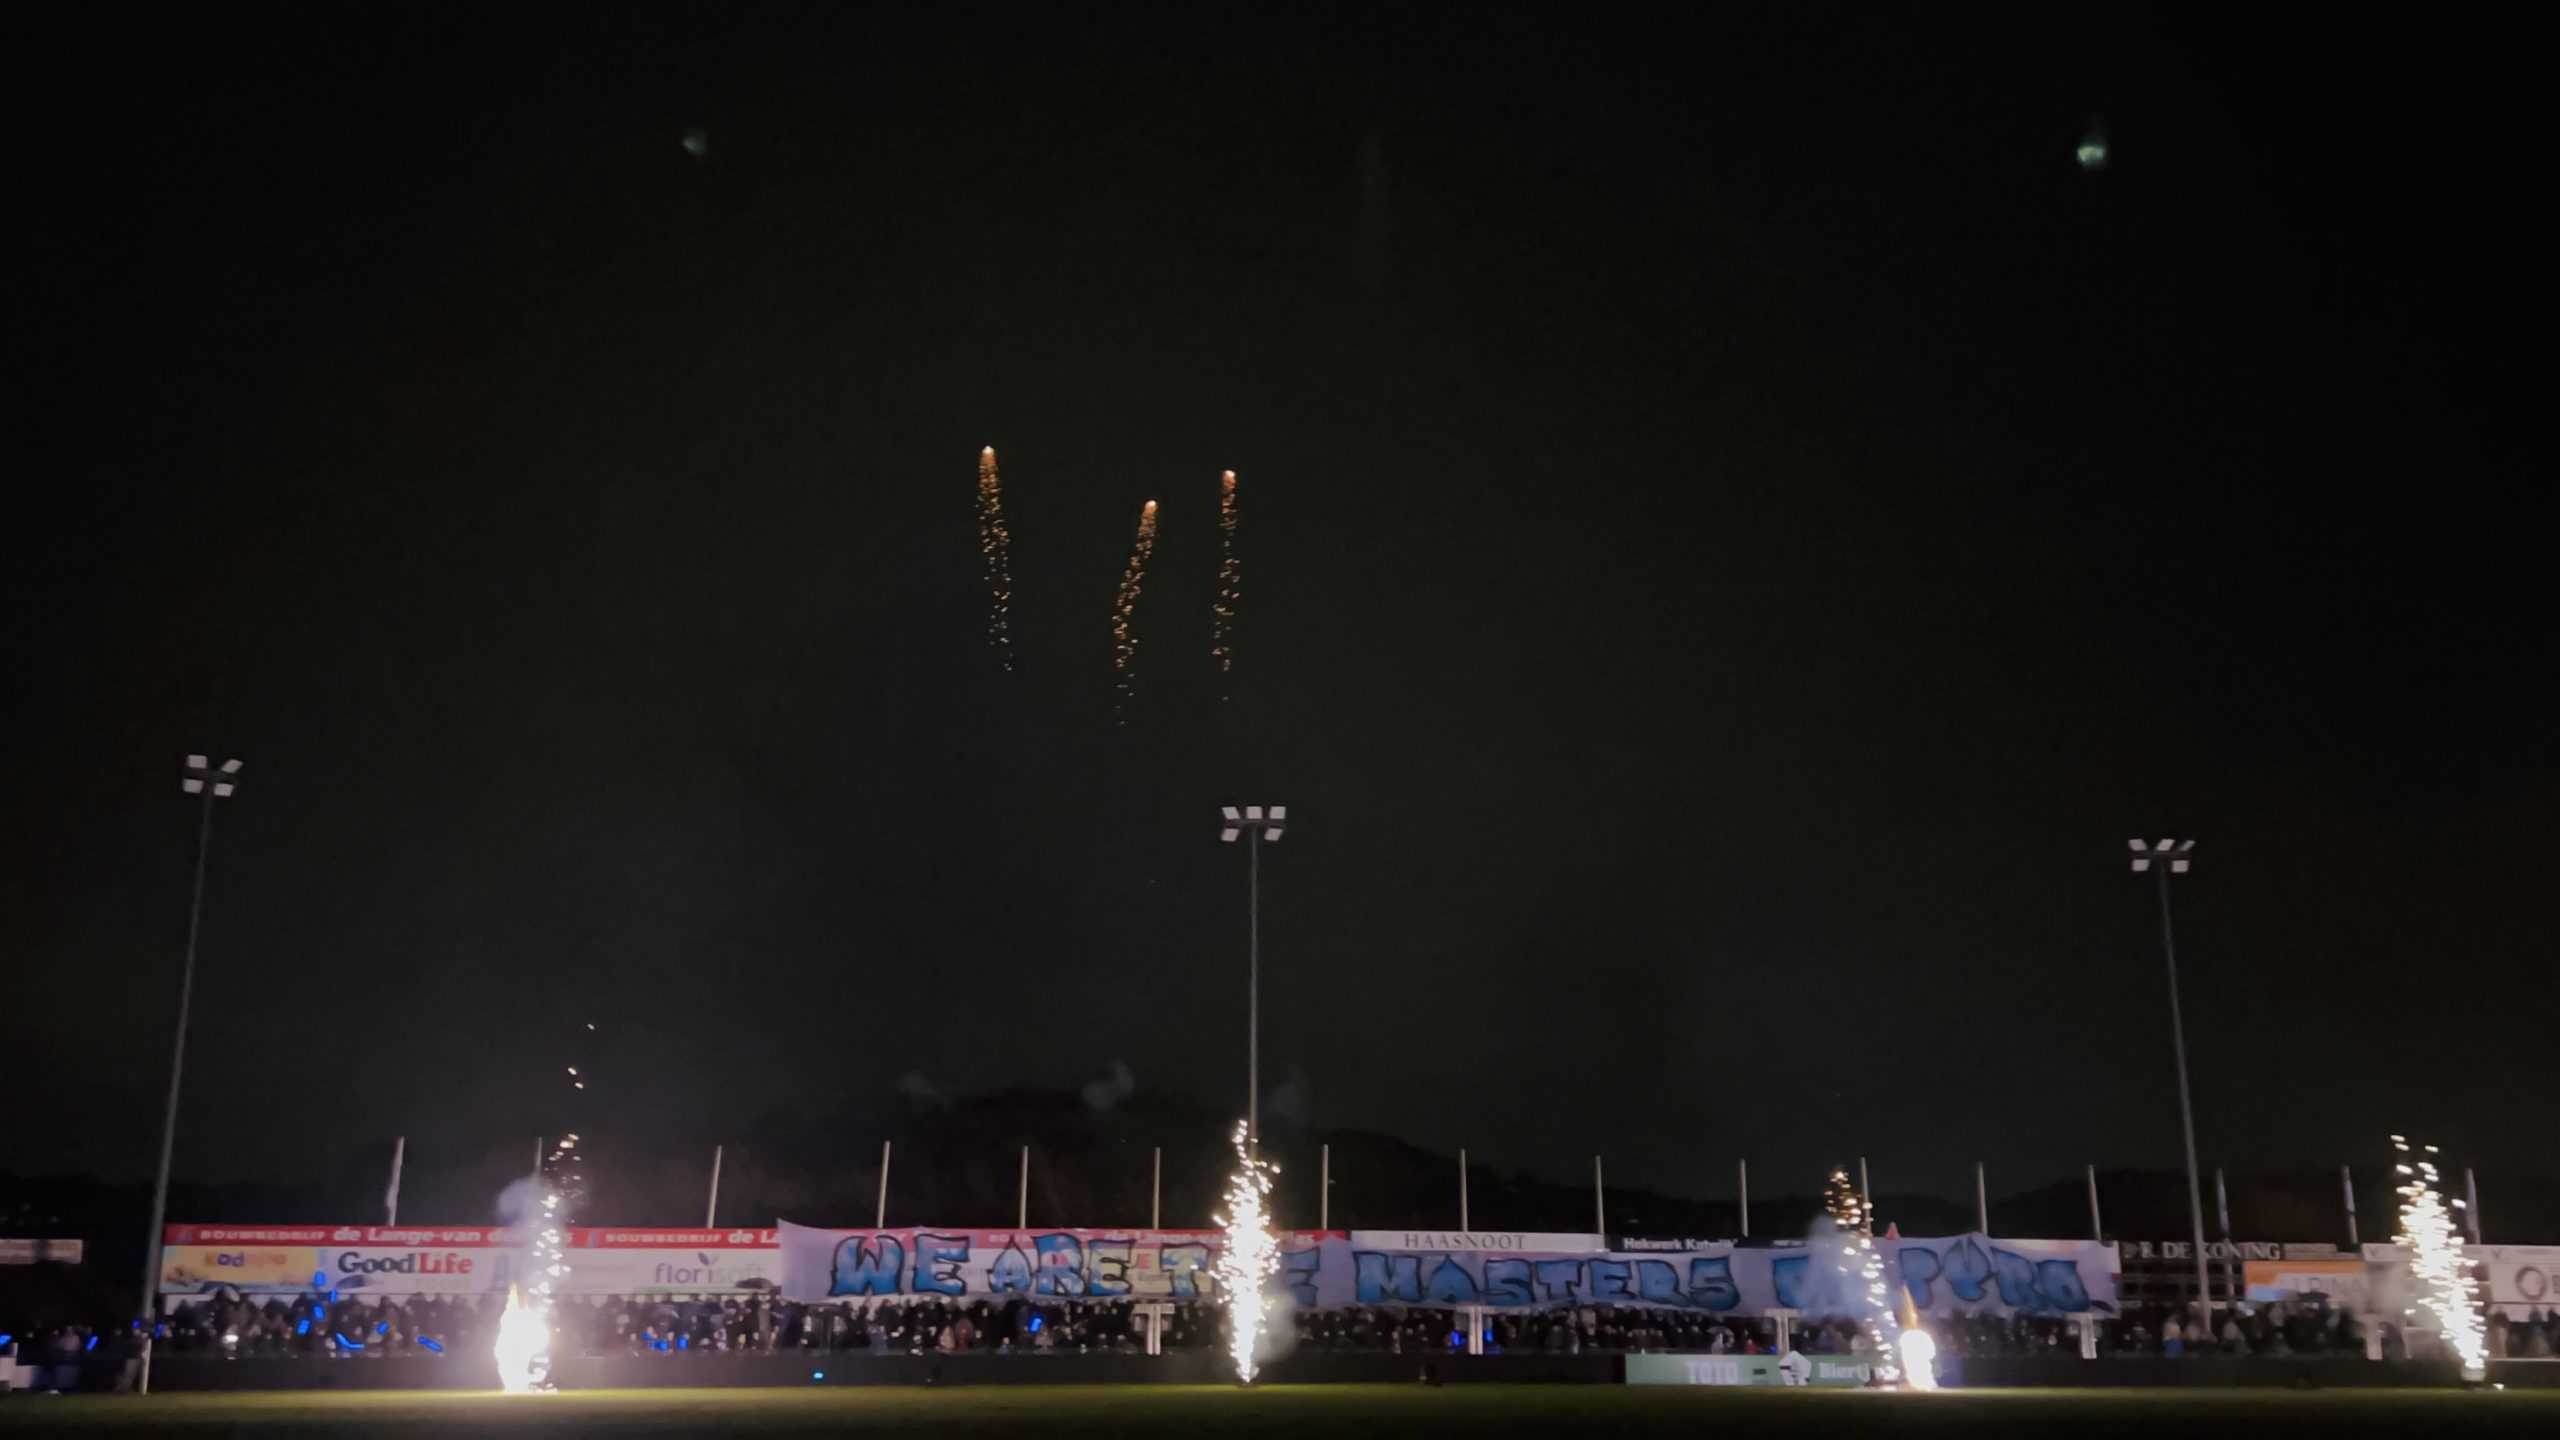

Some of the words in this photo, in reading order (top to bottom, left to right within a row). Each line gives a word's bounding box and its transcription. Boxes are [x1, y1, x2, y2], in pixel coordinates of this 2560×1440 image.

[334, 1226, 361, 1241] de
[728, 1229, 753, 1243] de
[1404, 1233, 1526, 1249] HAASNOOT
[338, 1251, 473, 1274] GoodLife
[830, 1233, 971, 1297] WE
[987, 1232, 1136, 1297] ARE
[1352, 1248, 1741, 1312] MASTERS
